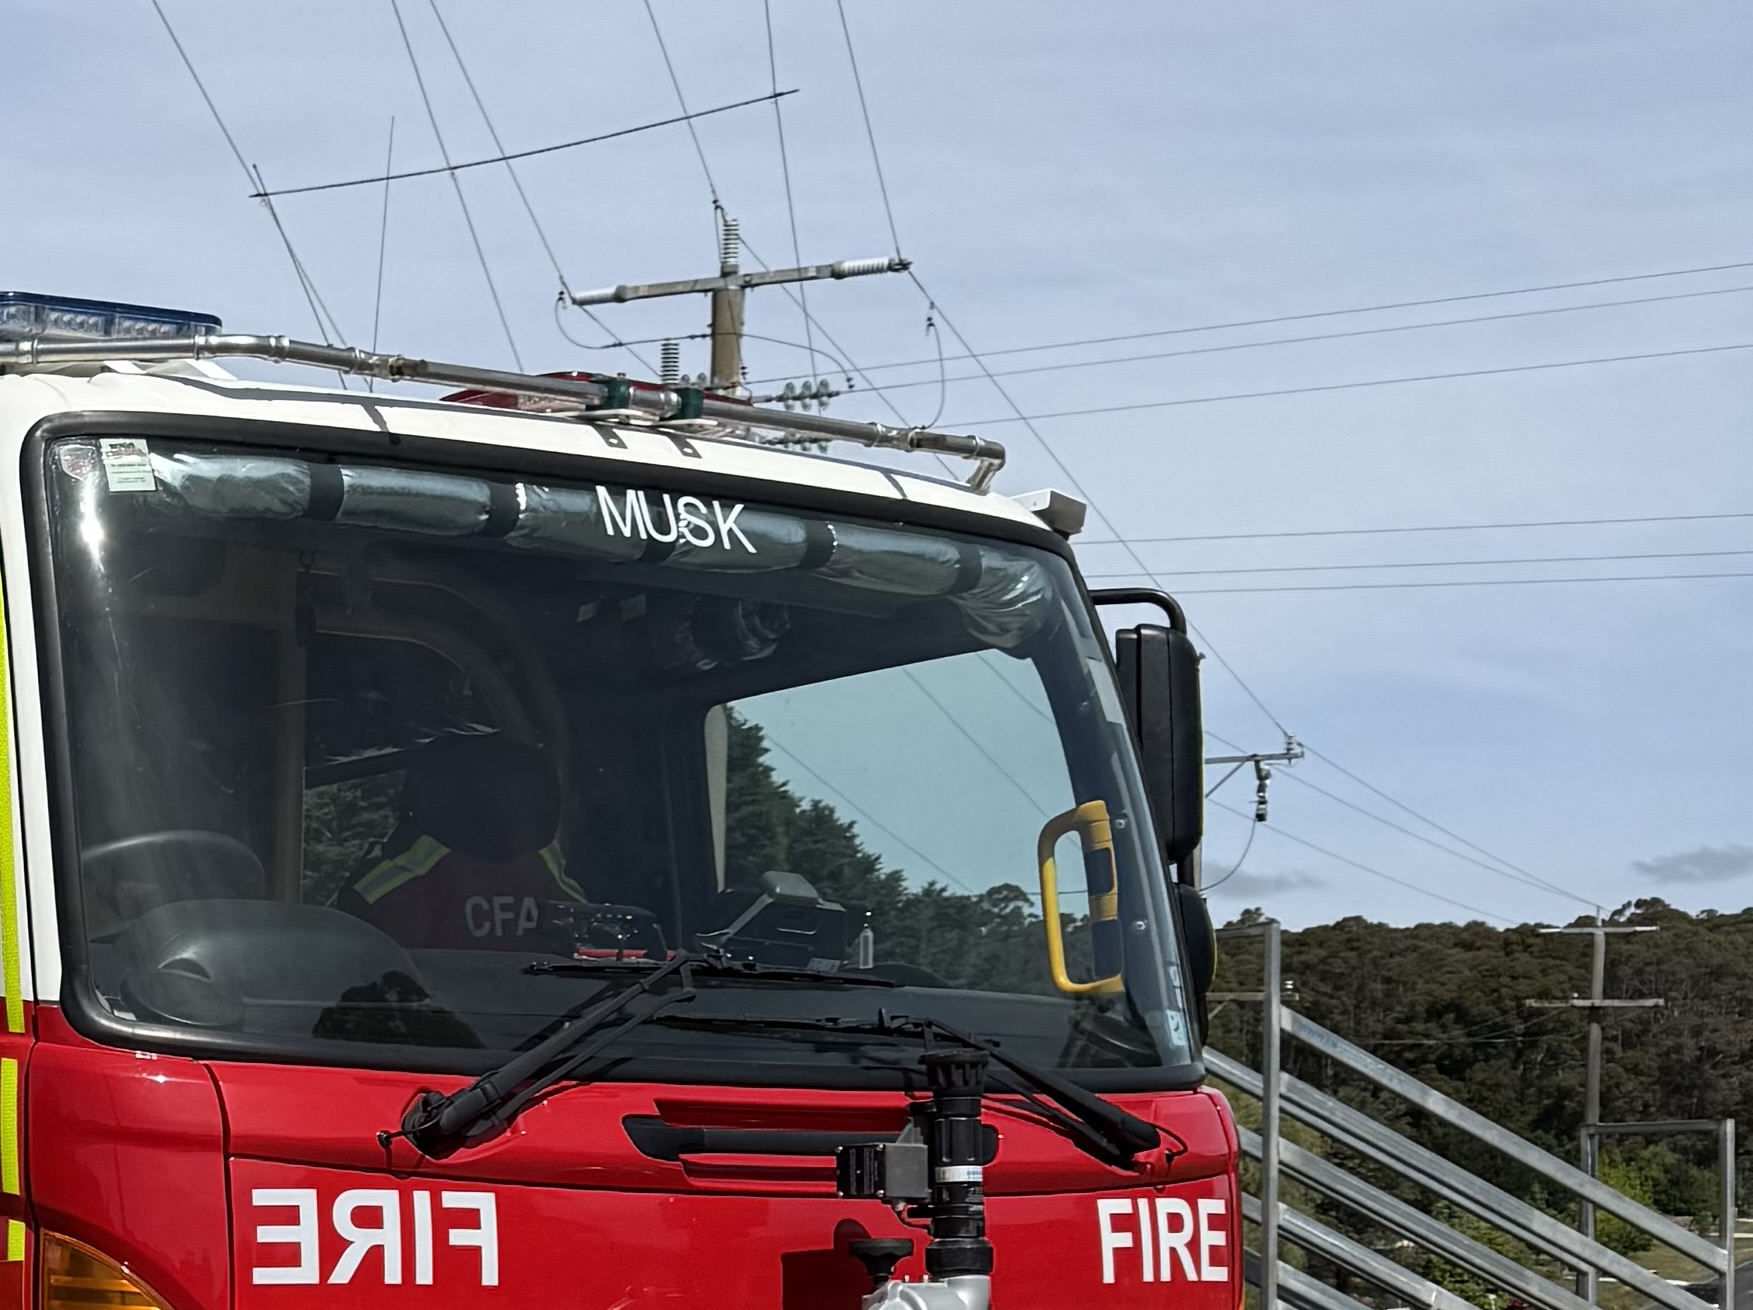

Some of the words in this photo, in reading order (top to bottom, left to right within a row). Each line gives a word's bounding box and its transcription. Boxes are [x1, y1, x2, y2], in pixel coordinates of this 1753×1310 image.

[595, 485, 758, 554] MUSK
[464, 895, 539, 938] CFA
[1096, 1197, 1229, 1285] FIRE
